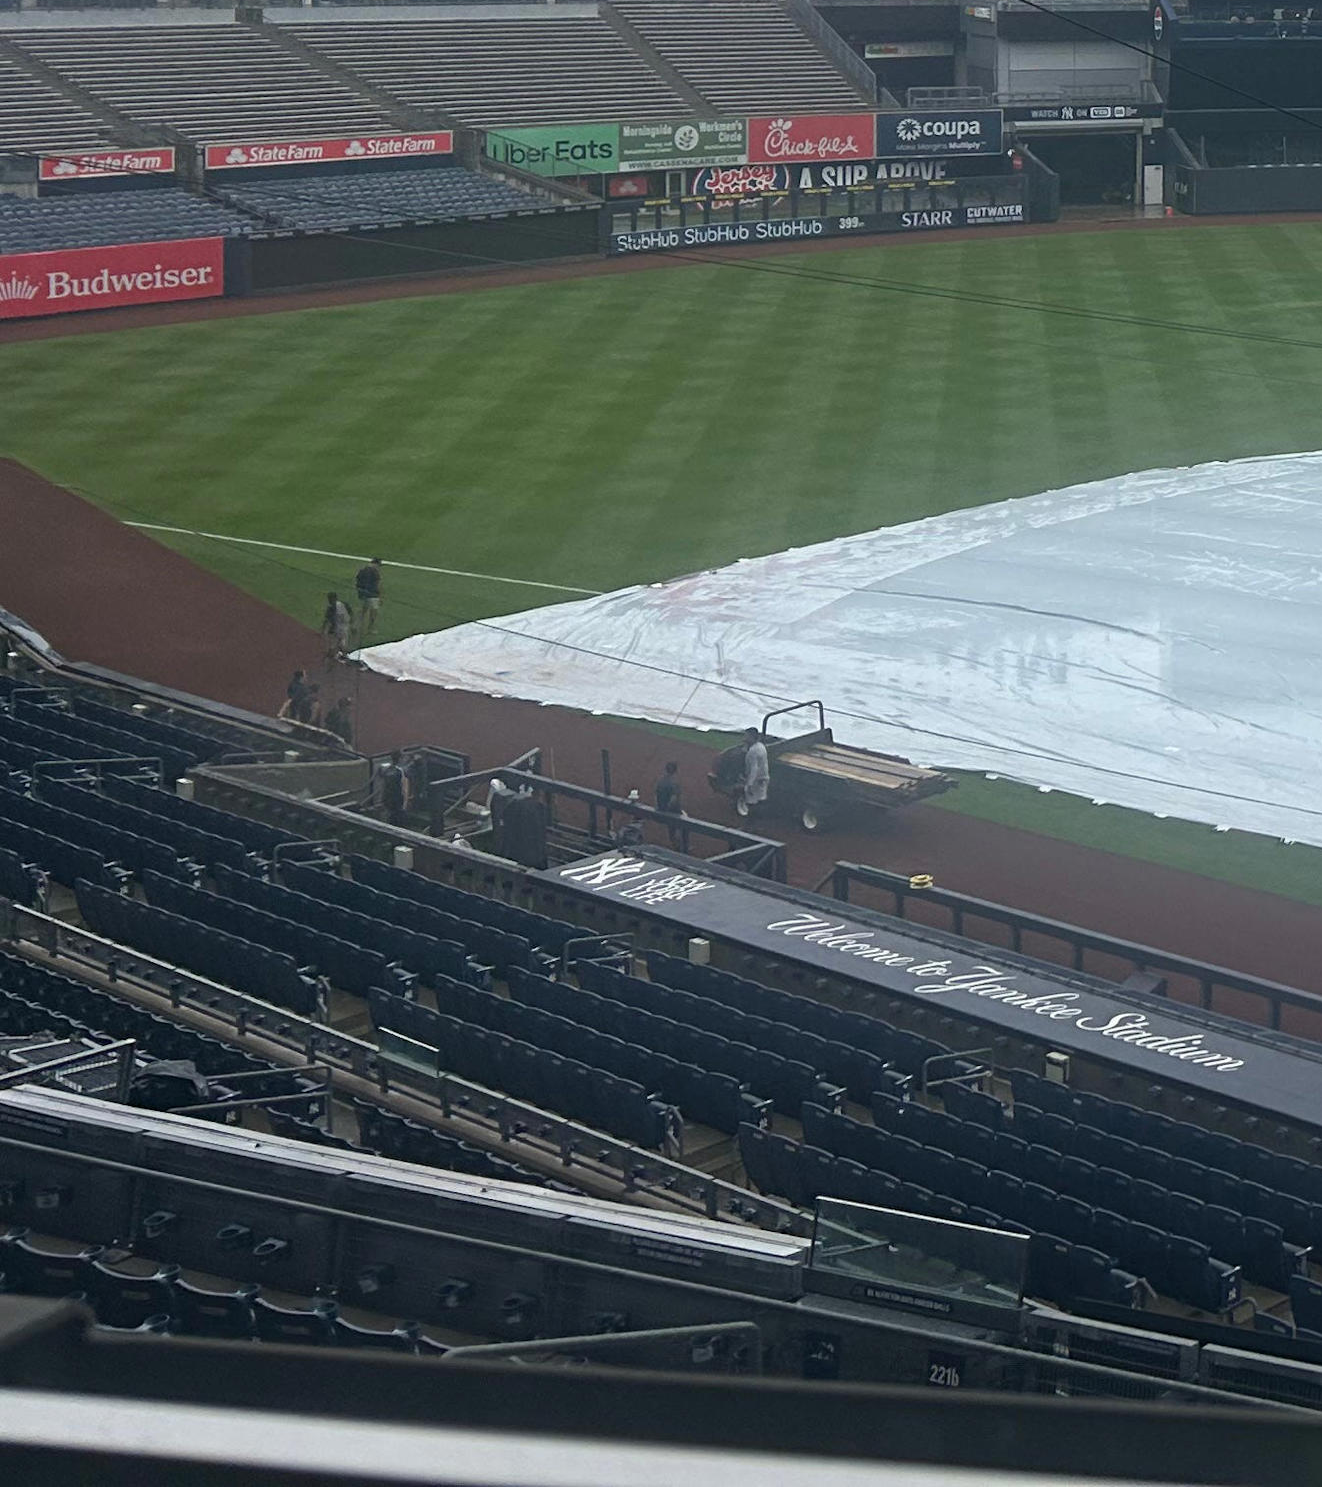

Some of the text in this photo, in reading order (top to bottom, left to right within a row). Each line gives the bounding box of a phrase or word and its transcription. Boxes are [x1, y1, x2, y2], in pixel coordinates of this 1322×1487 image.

[764, 119, 858, 157] Chick-fil-A
[923, 120, 980, 140] coupa
[493, 139, 613, 164] Uber Eats
[705, 165, 777, 189] Jersey
[800, 167, 813, 188] A
[902, 211, 952, 227] STARR
[967, 205, 1023, 217] CUTWATER
[839, 217, 859, 229] 399
[617, 220, 823, 252] StubHub StubHub StubHub
[46, 263, 212, 300] Budweiser
[767, 913, 1244, 1072] Welcome to Yankee Stadium
[929, 1364, 960, 1387] 221b
